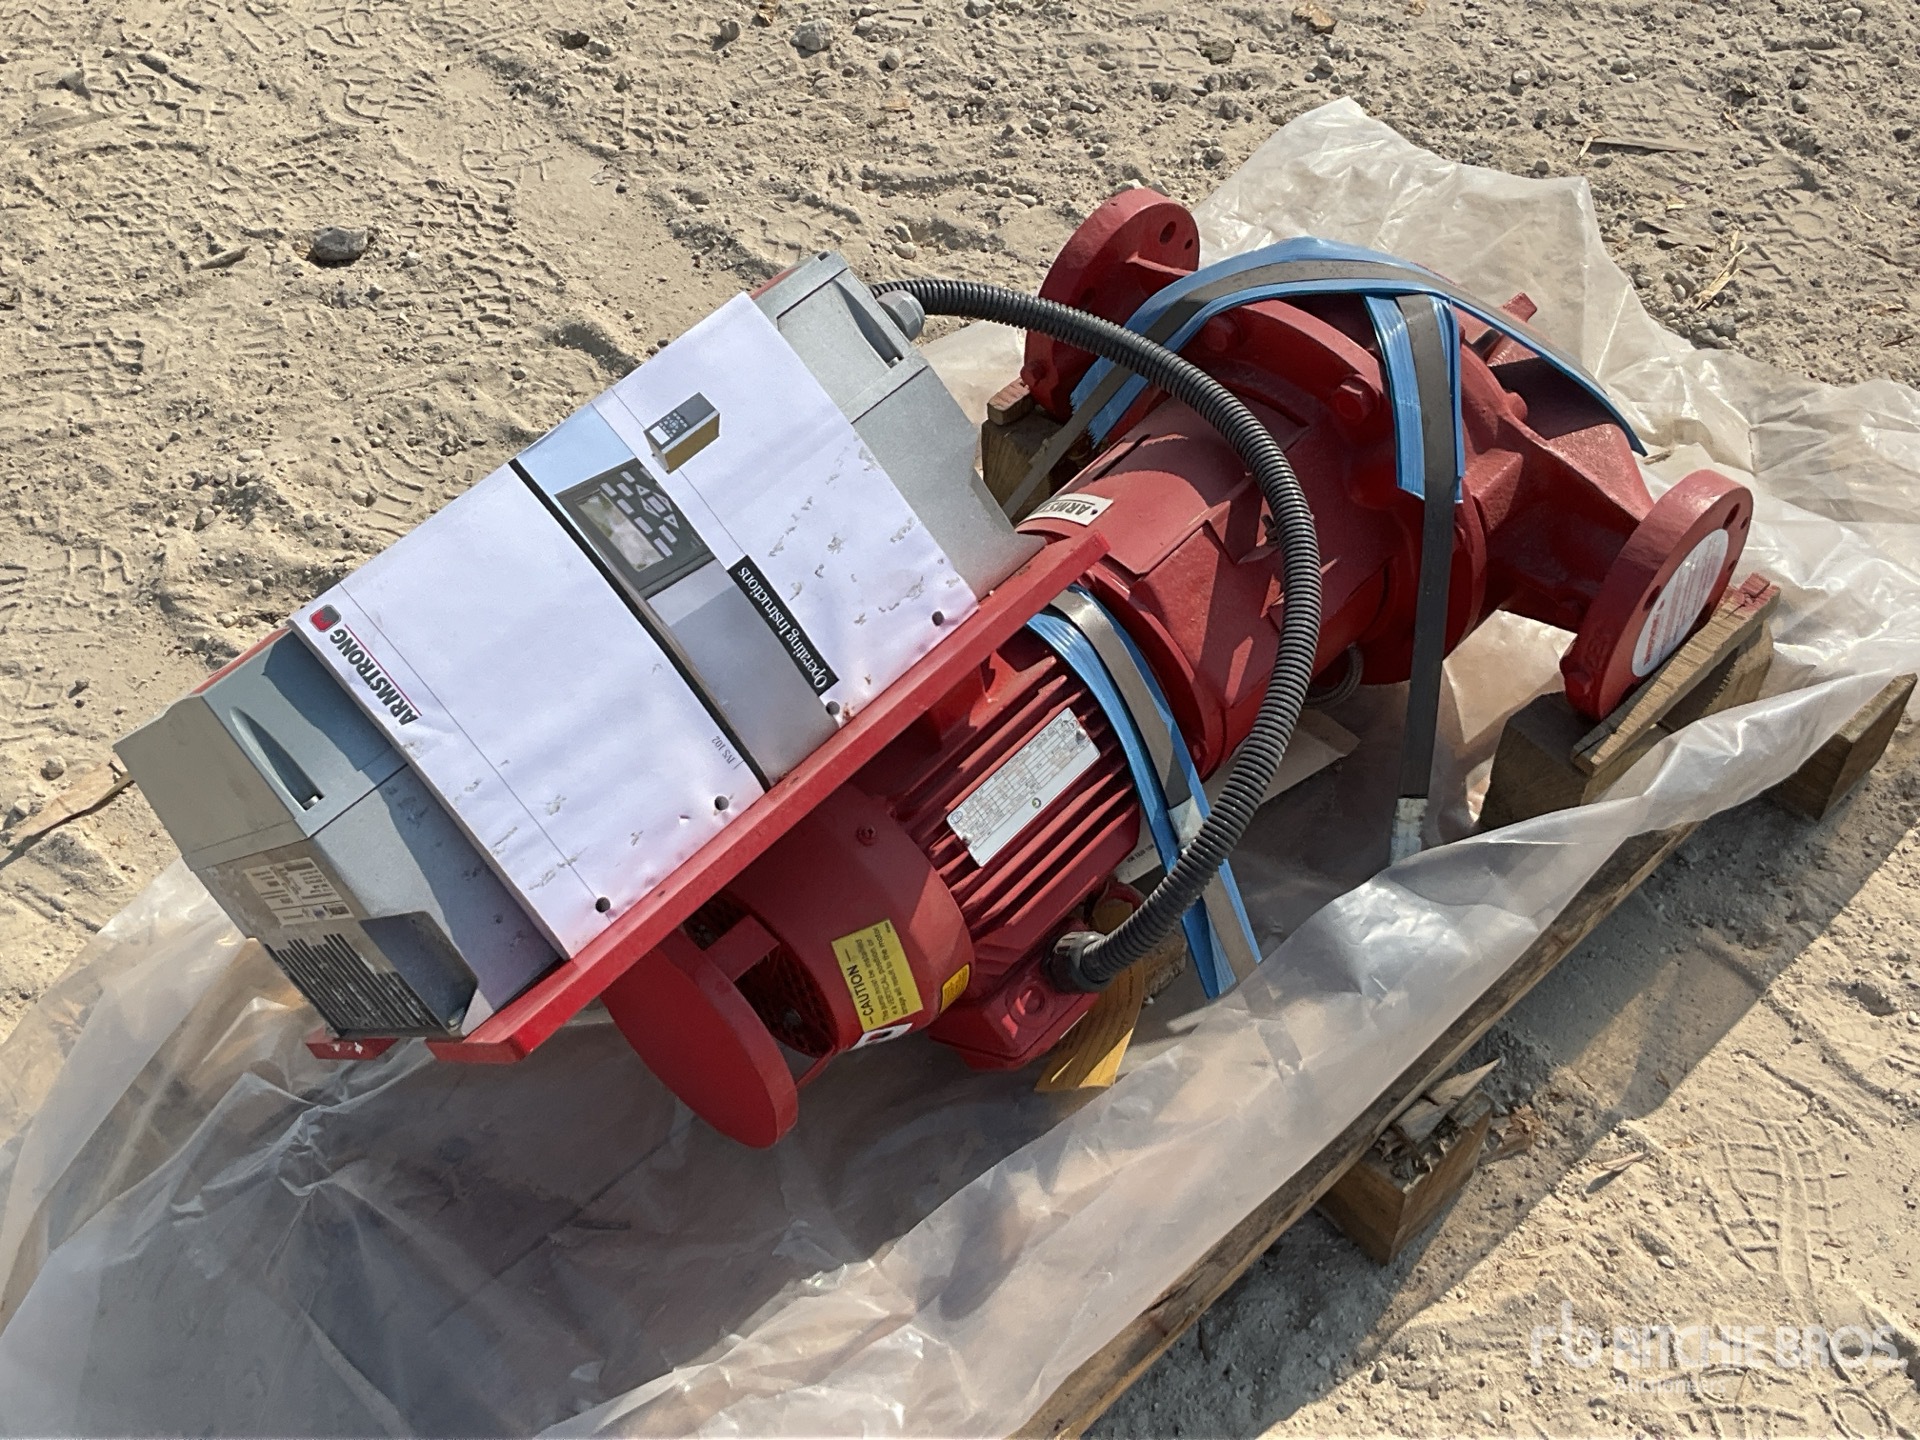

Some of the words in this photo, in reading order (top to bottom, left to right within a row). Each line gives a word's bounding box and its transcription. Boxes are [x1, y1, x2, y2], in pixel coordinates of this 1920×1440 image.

[737, 566, 790, 635] Instructions
[329, 628, 418, 725] ARMSTRONG
[785, 628, 828, 688] Operating
[710, 735, 726, 751] 102
[855, 939, 870, 968] installed
[880, 948, 889, 961] the
[847, 965, 873, 1016] CAUTION
[879, 974, 895, 1005] VERTICAL
